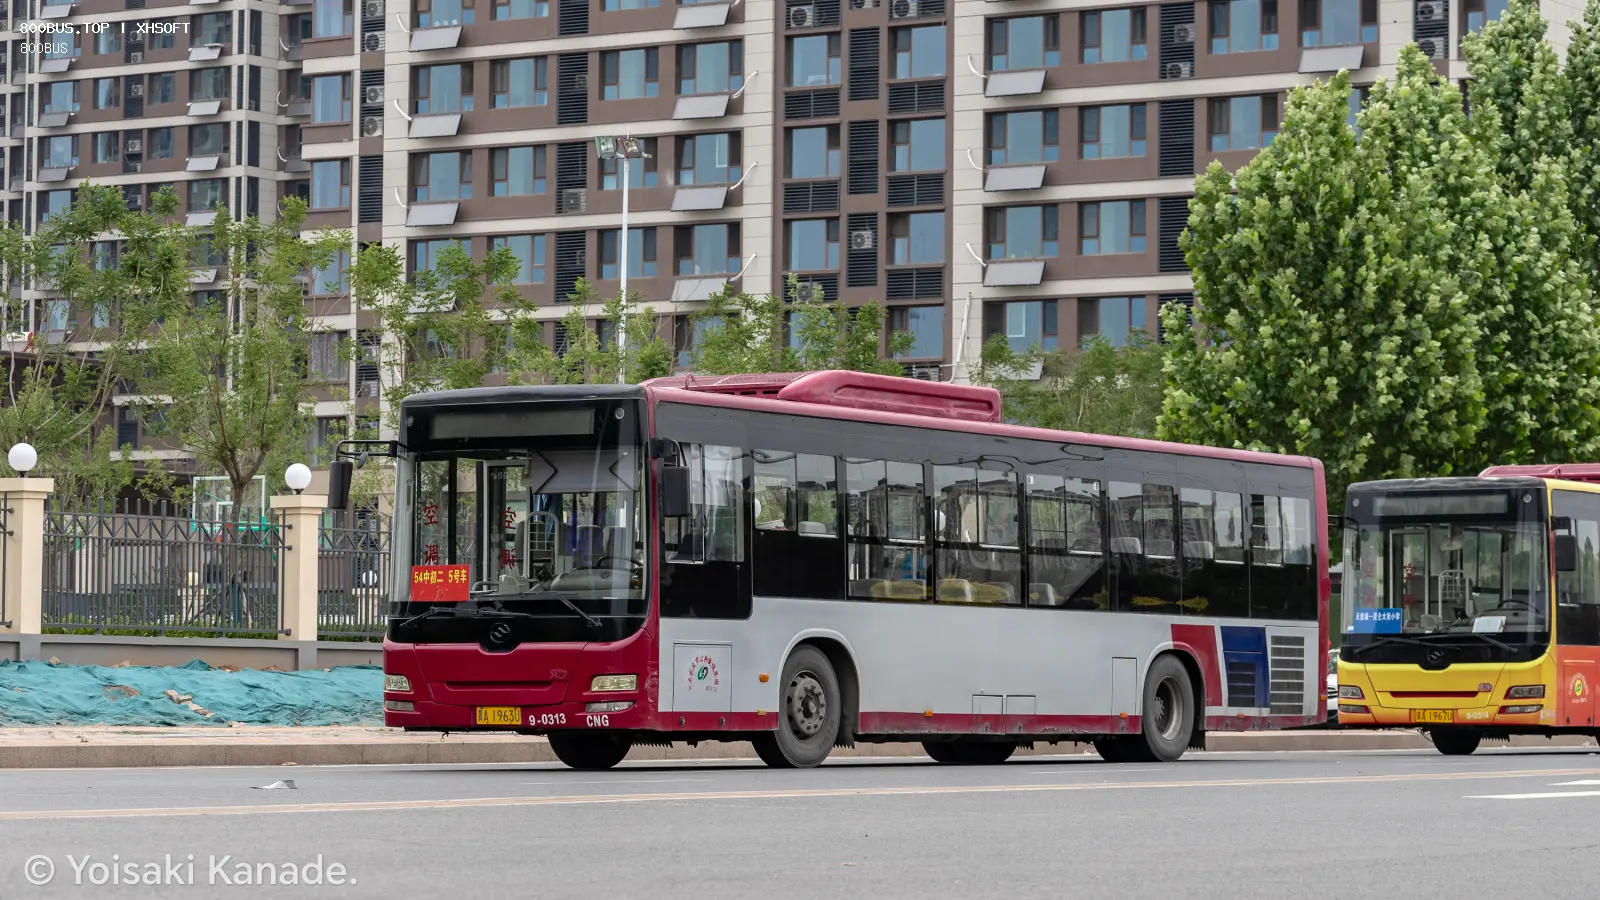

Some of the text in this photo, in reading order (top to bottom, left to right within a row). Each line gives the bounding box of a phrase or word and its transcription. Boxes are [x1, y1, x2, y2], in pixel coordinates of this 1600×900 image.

[414, 568, 467, 584] 54中初二 5号车
[529, 713, 609, 727] 9-0313 CNG
